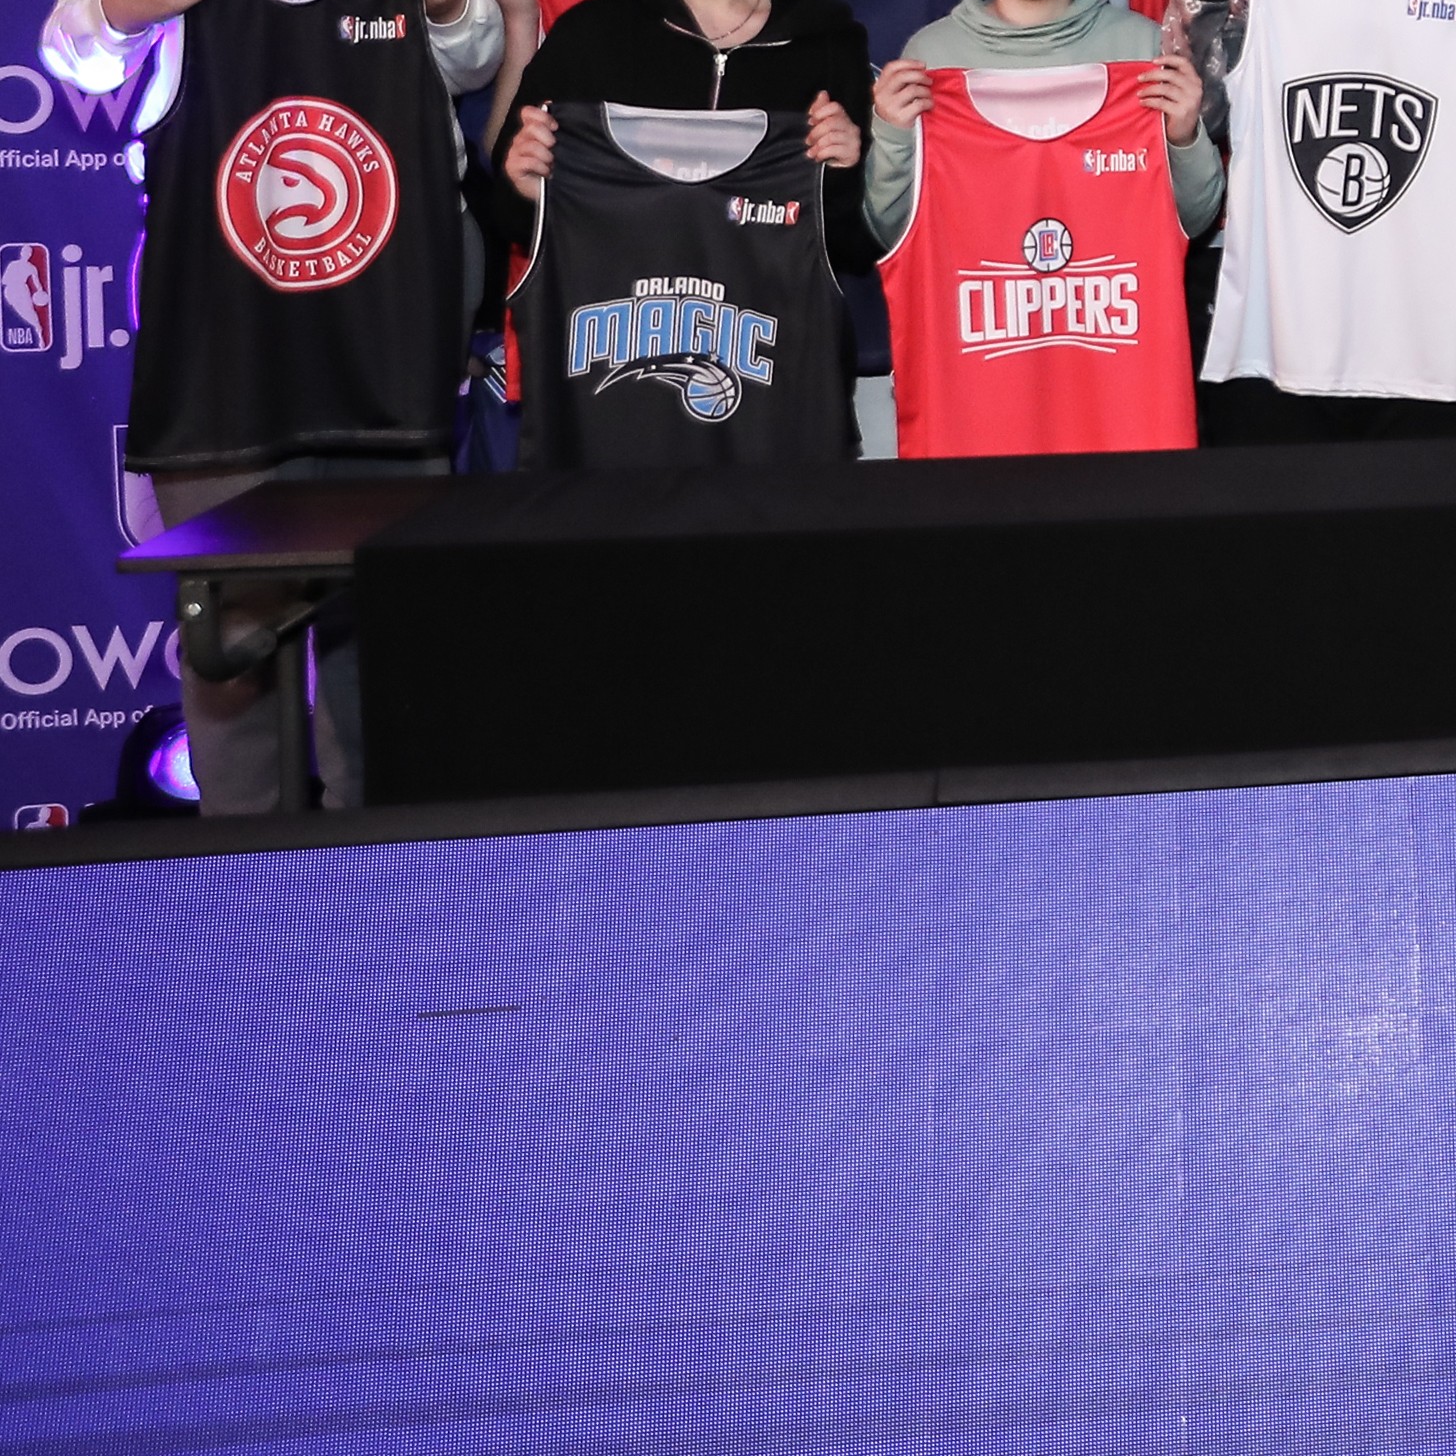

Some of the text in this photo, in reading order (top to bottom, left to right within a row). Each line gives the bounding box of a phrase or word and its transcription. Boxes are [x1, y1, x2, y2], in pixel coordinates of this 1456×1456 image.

[353, 16, 396, 44] jr.nba
[0, 65, 145, 134] OW
[1293, 83, 1424, 152] NETS
[0, 149, 59, 167] fficial
[64, 150, 107, 171] App
[235, 110, 380, 183] ATLANTA HAWKS
[1095, 150, 1136, 176] jr.nba
[1342, 153, 1366, 206] B
[740, 198, 785, 225] jr.nba
[254, 232, 372, 277] BASKETBALL
[60, 244, 130, 369] jr.
[635, 276, 725, 301] ORLANDO
[958, 273, 1139, 343] CLIPPERS
[8, 328, 33, 344] NBA
[568, 295, 778, 385] MAGIC
[1, 707, 78, 730] Official
[84, 708, 126, 729] App
